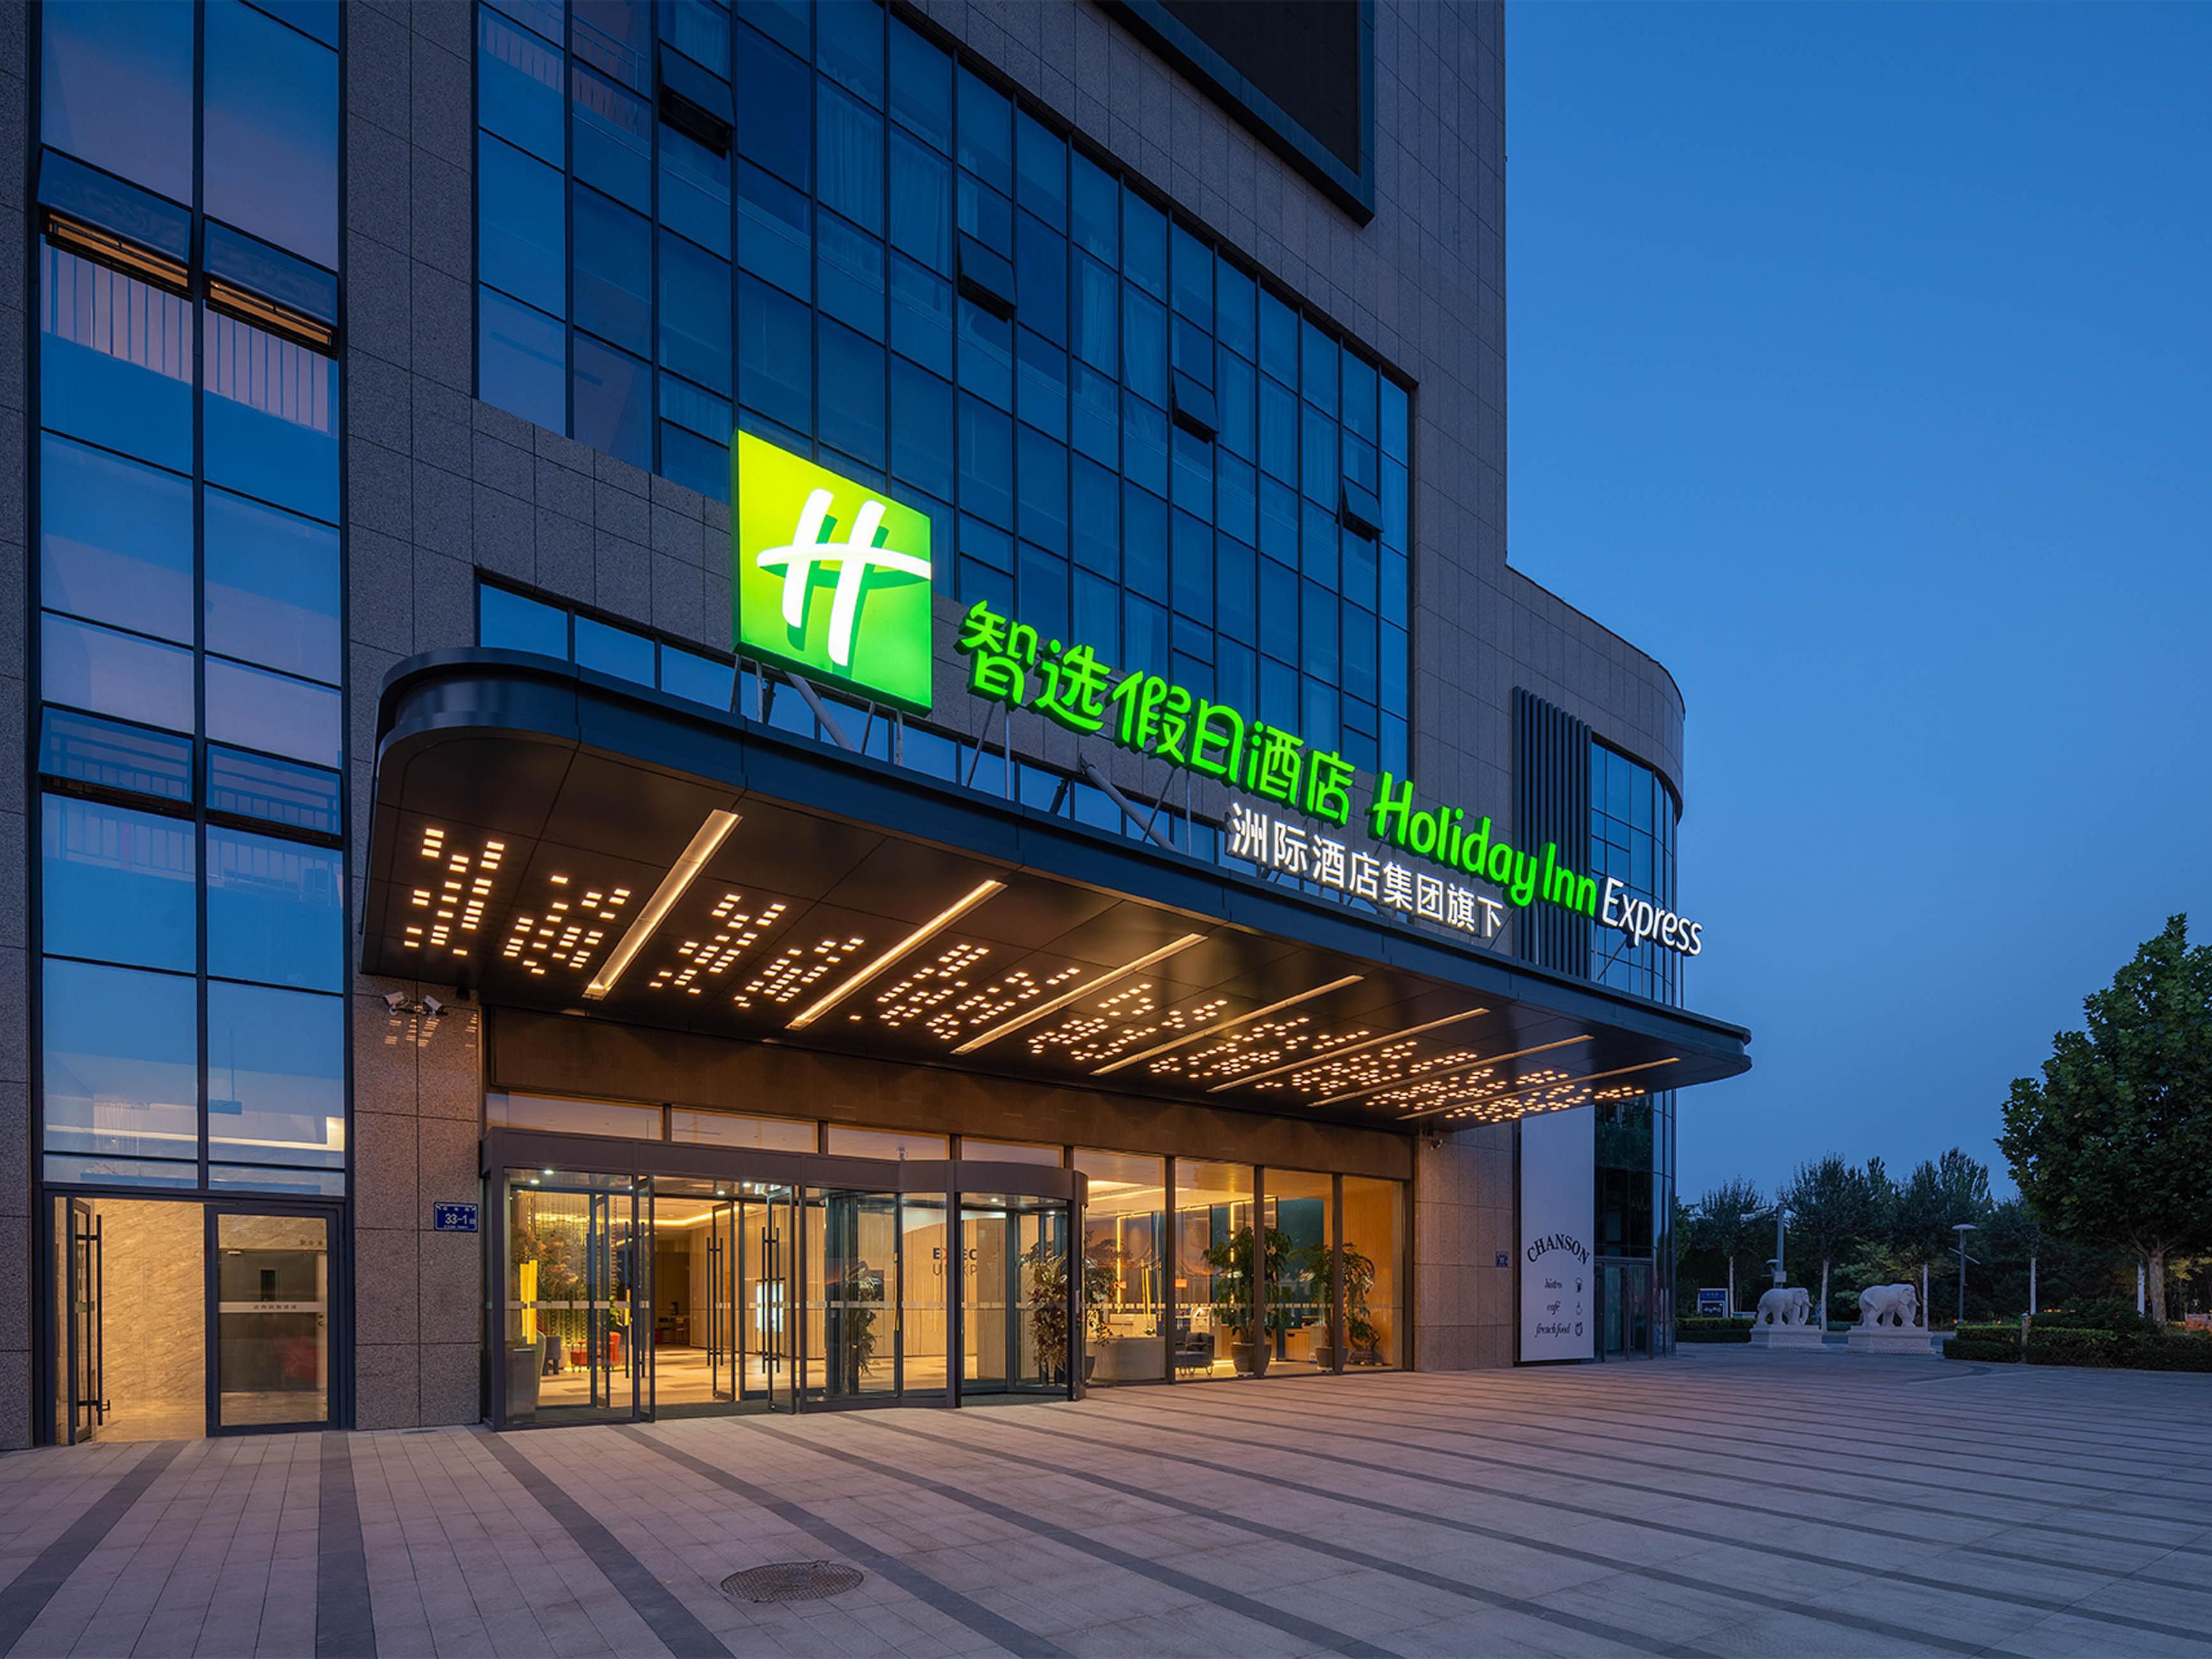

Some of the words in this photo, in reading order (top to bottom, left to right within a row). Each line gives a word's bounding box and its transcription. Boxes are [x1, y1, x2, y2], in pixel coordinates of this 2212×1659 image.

[957, 600, 1356, 826] 智选假日酒店
[1231, 801, 1504, 939] 洲际酒店集团旗下
[1370, 770, 1539, 909] Holiday
[1542, 842, 1597, 918] Inn
[1601, 876, 1704, 956] Express
[1527, 1233, 1590, 1265] CHANSON
